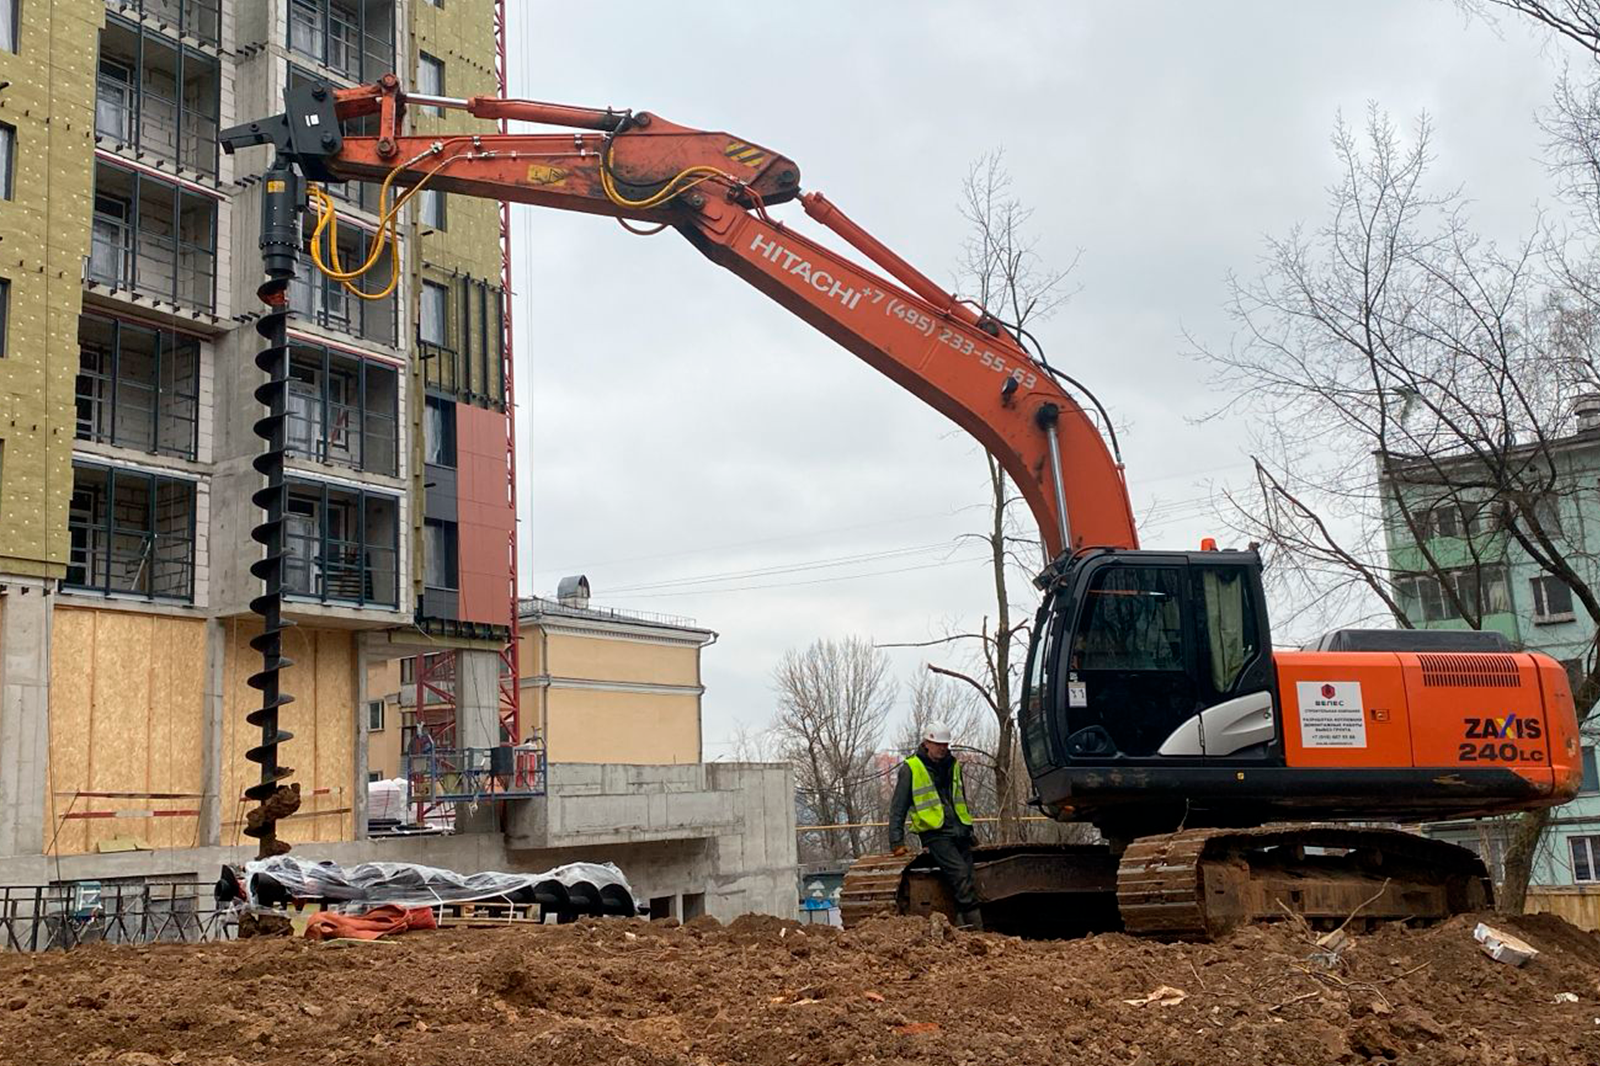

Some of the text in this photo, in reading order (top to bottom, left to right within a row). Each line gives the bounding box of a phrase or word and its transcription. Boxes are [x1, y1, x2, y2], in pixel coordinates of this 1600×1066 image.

[750, 234, 863, 310] HITACHI
[861, 286, 1037, 390] +7 (495) 233-55-63
[1464, 713, 1541, 739] ZAXIS
